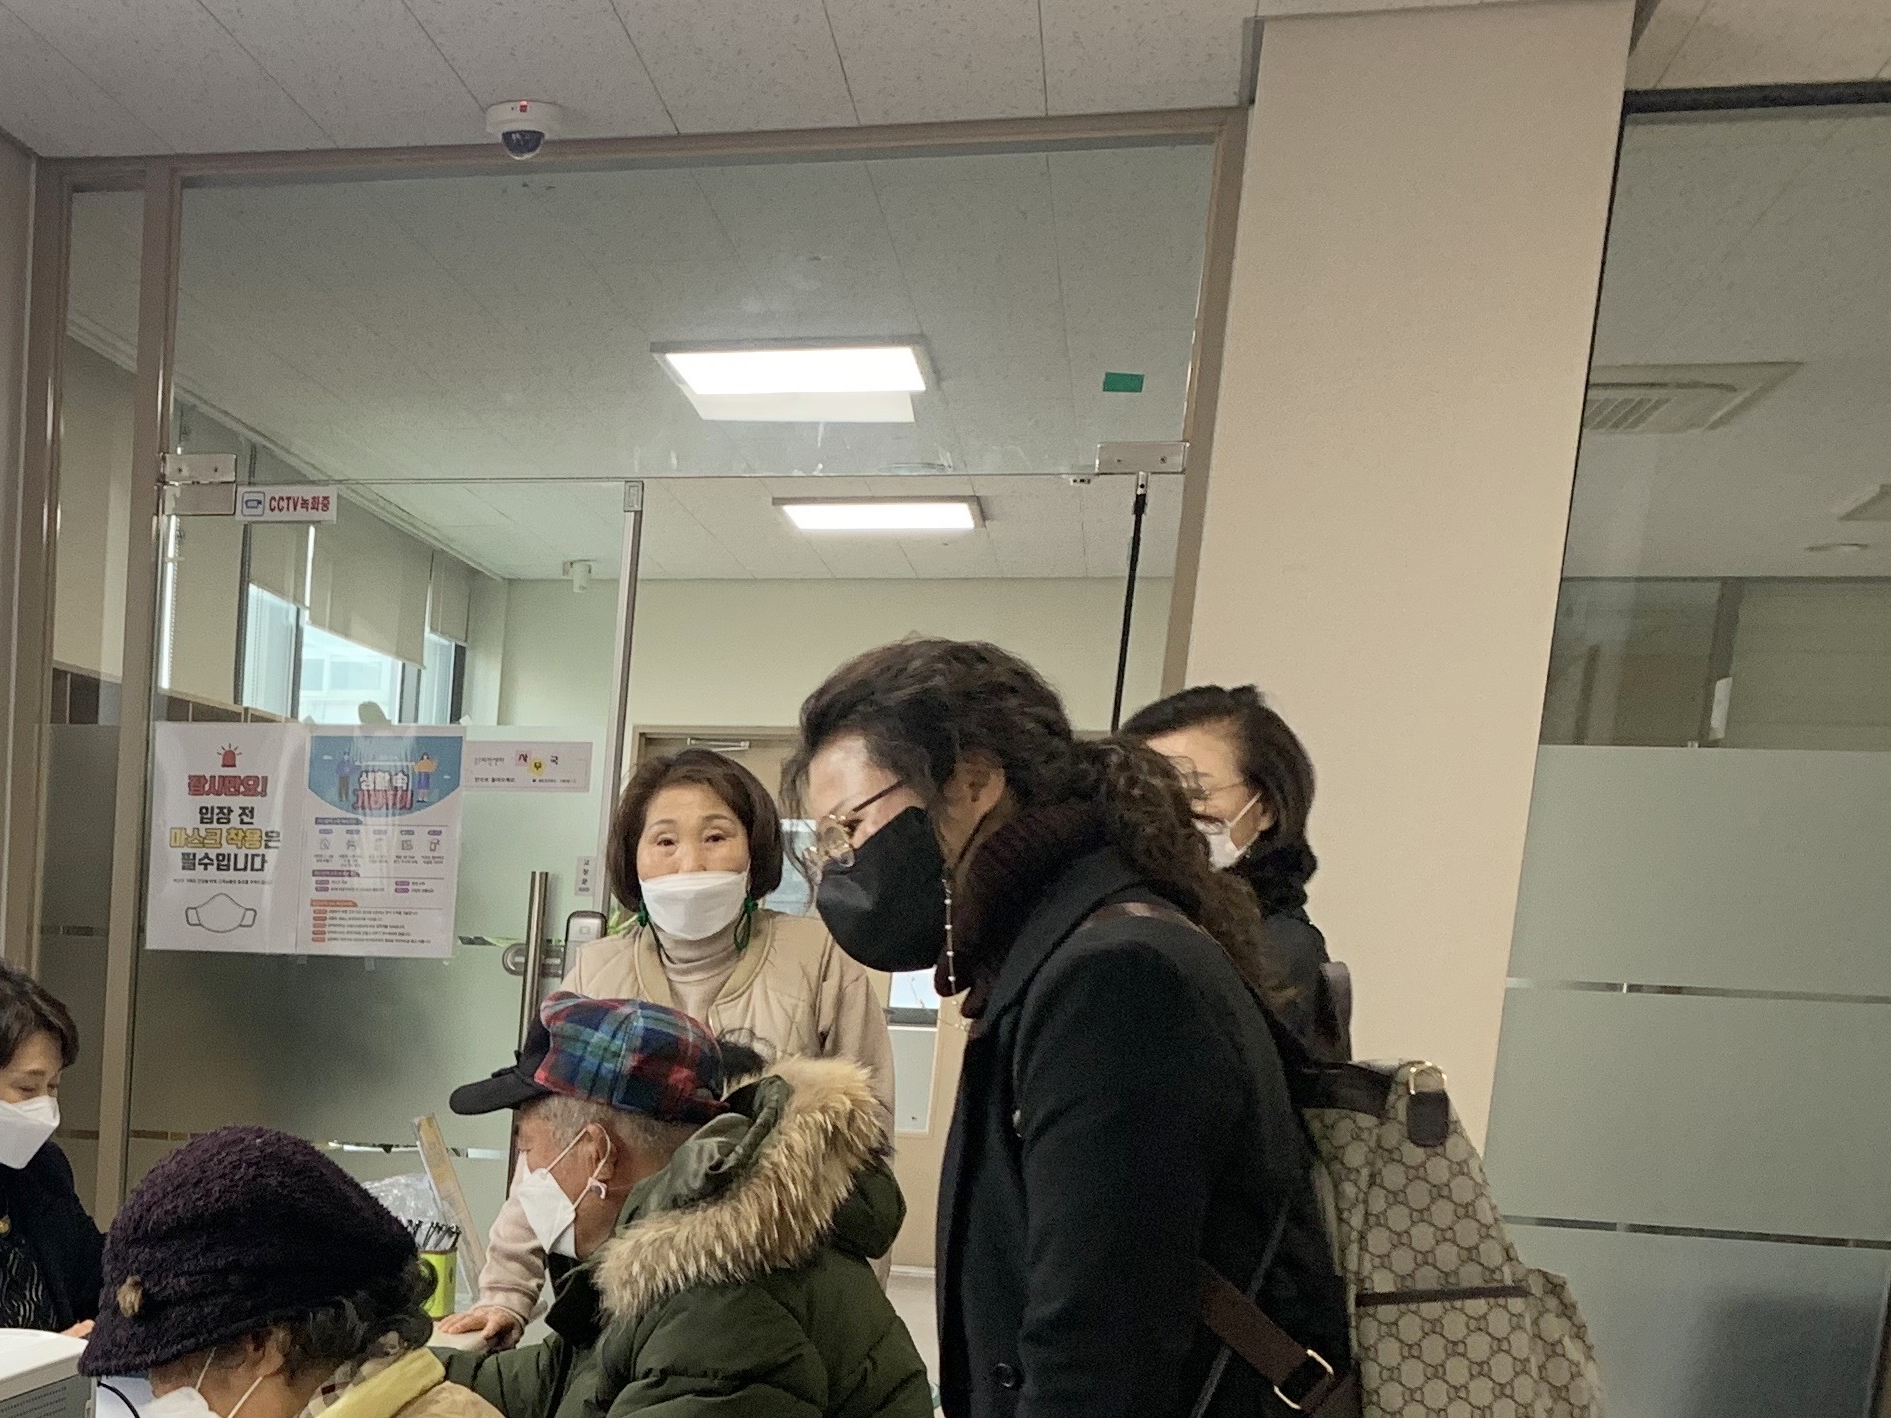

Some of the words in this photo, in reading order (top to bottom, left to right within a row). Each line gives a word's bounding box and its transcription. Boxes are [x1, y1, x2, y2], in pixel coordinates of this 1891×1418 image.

[198, 805, 234, 825] 입장
[238, 806, 255, 825] 전
[169, 827, 223, 849] 마스크
[181, 852, 268, 872] 필수입니다
